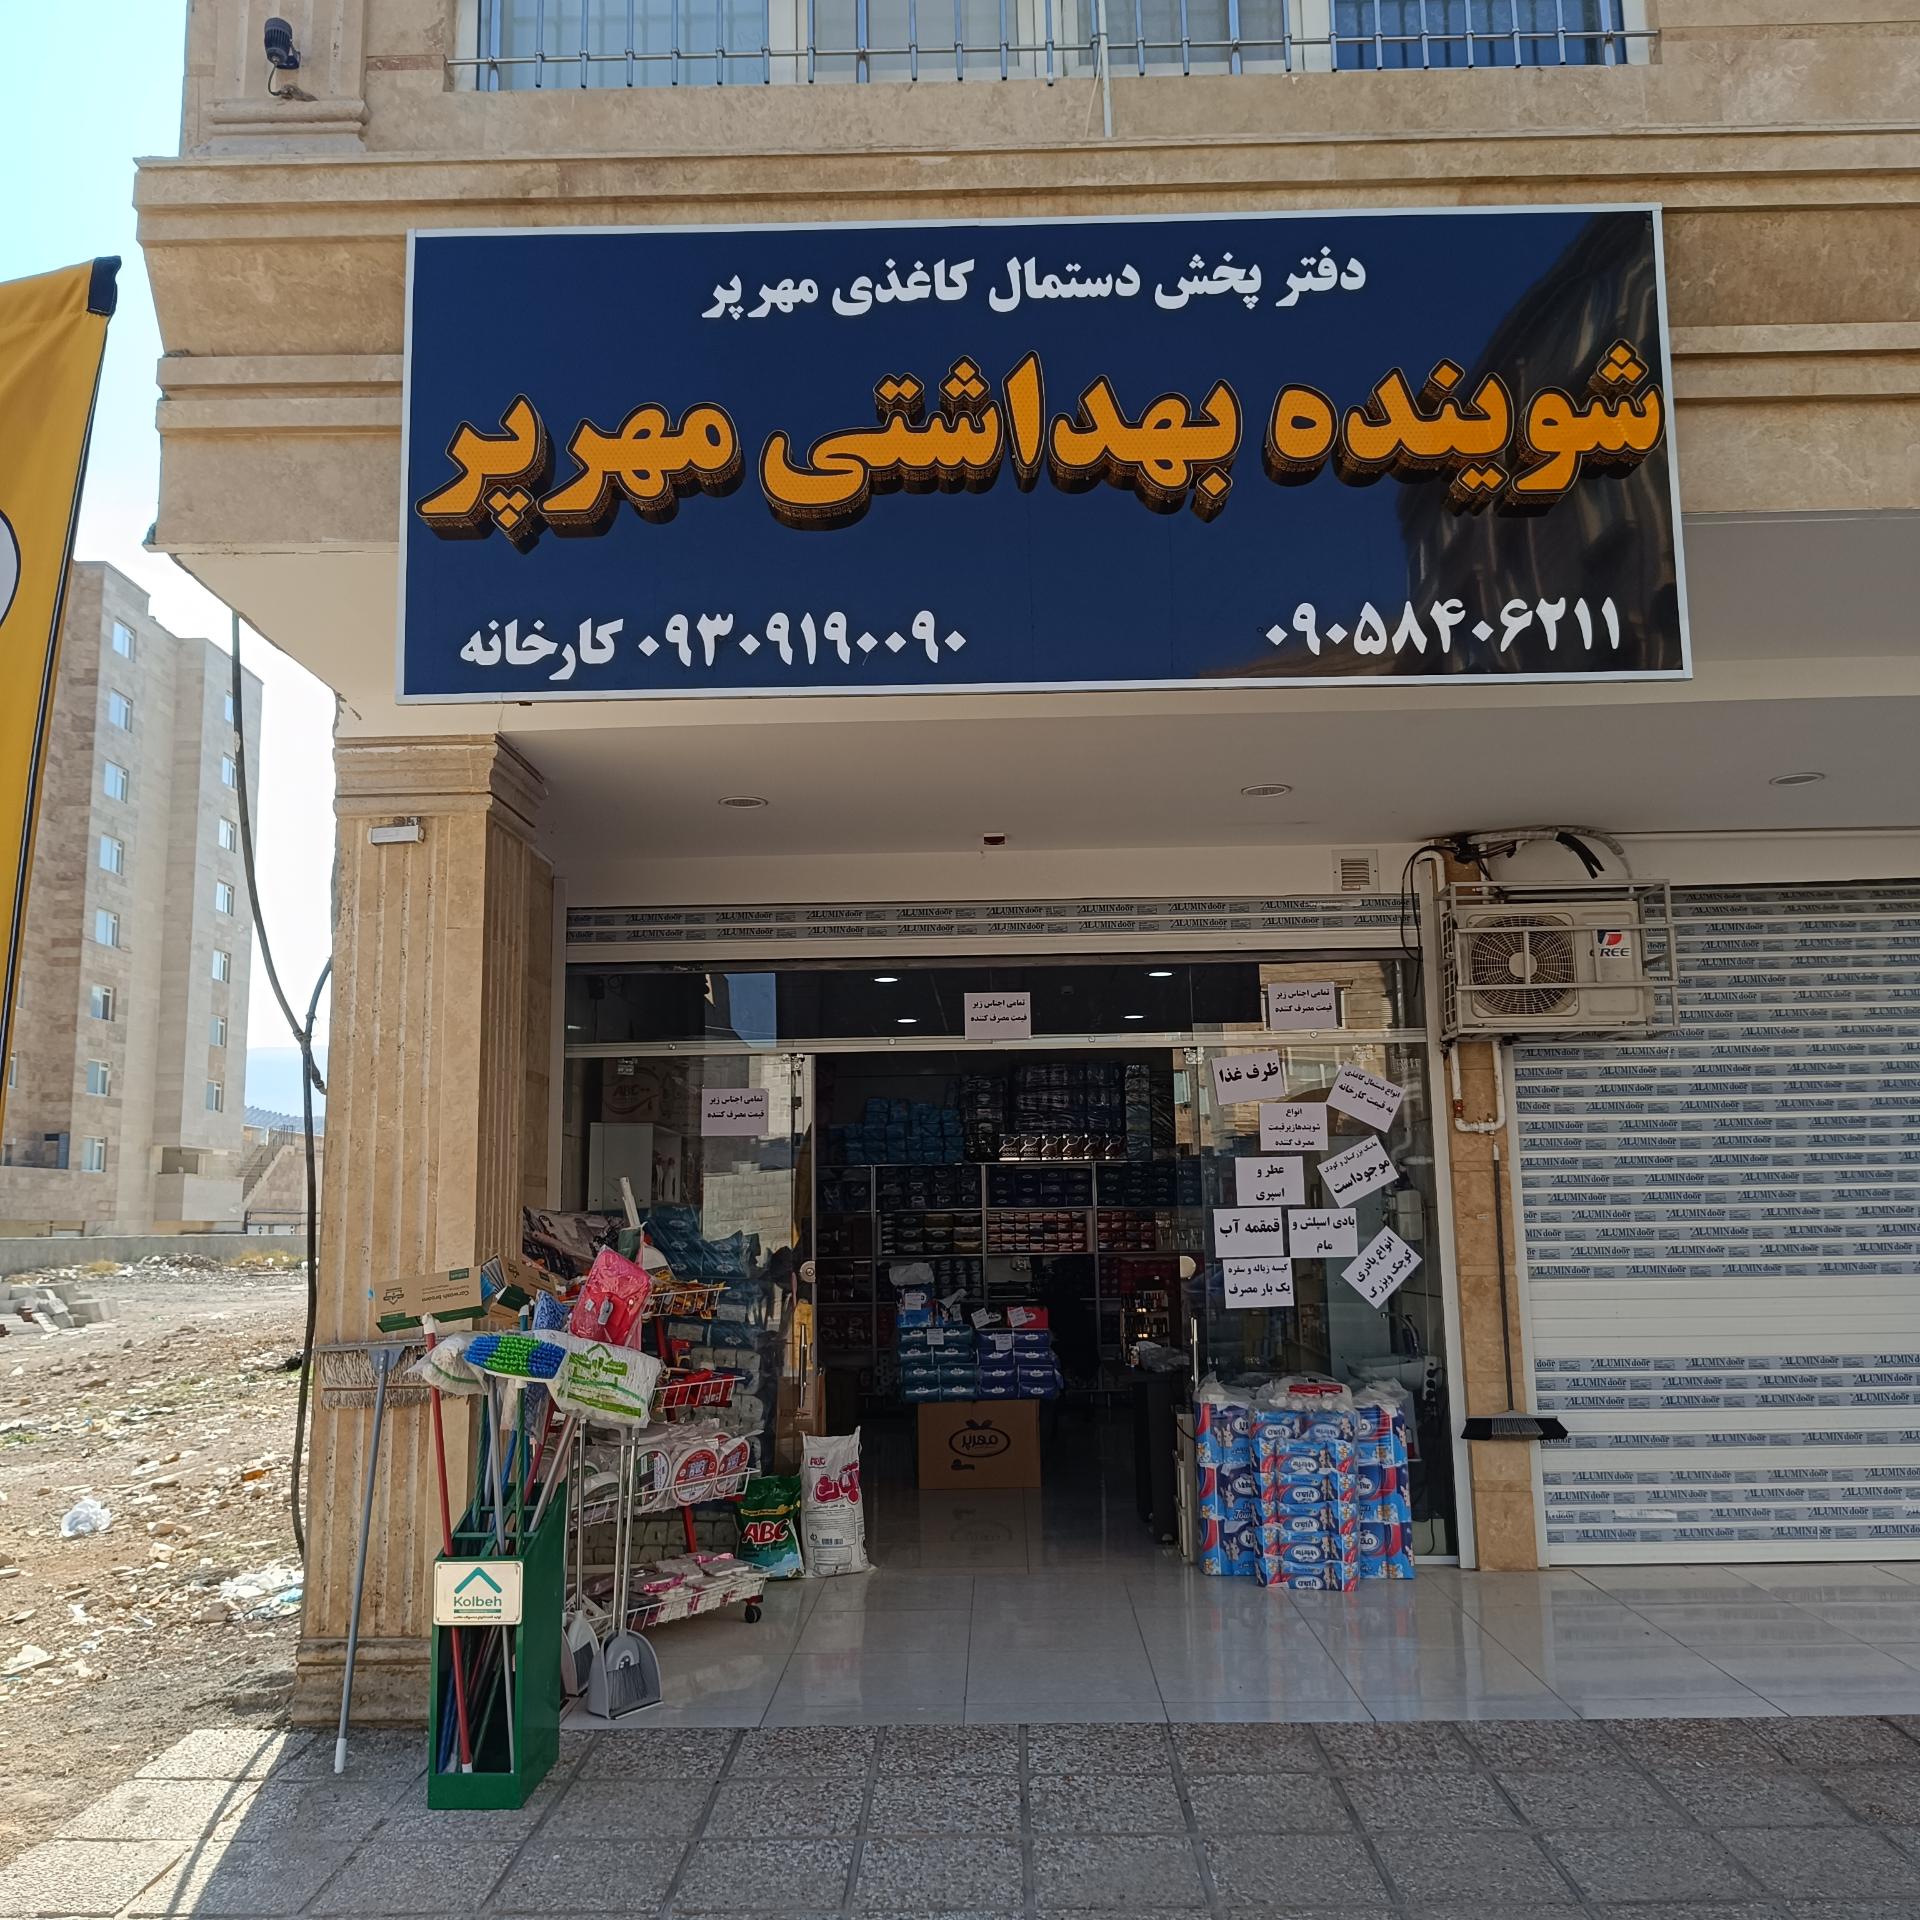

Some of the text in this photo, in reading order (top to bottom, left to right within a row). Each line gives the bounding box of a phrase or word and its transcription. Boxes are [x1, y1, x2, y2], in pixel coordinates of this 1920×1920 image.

[988, 255, 1141, 313] دستمال
[1154, 252, 1263, 309] پخش
[1275, 245, 1367, 307] دفتر
[831, 257, 976, 317] کاغذی
[759, 350, 1243, 522] بهداشتی
[1264, 338, 1667, 513] شوینده
[1265, 596, 1621, 656] ۰۹۰۵۸۴۰۶۲۱۱
[459, 610, 967, 681] کارخانه ۰۹۳۰۹۱۹۰۰۹۰
[1219, 1062, 1279, 1083] ظرف غذا
[1286, 1108, 1302, 1117] انواع
[1257, 1164, 1284, 1178] عطر و
[1256, 1188, 1285, 1201] اسپری
[1220, 1218, 1280, 1238] قمقمه آب
[1292, 1216, 1355, 1230] بادی اسپلش و
[1317, 1240, 1332, 1254] مام
[1376, 1236, 1395, 1260] انواع
[1253, 1264, 1270, 1274] زباله
[1272, 1263, 1288, 1272] کیسه
[1228, 1282, 1290, 1297] یک بار مصرف
[741, 1518, 790, 1544] ABC
[454, 1596, 502, 1607] Kolbeh
